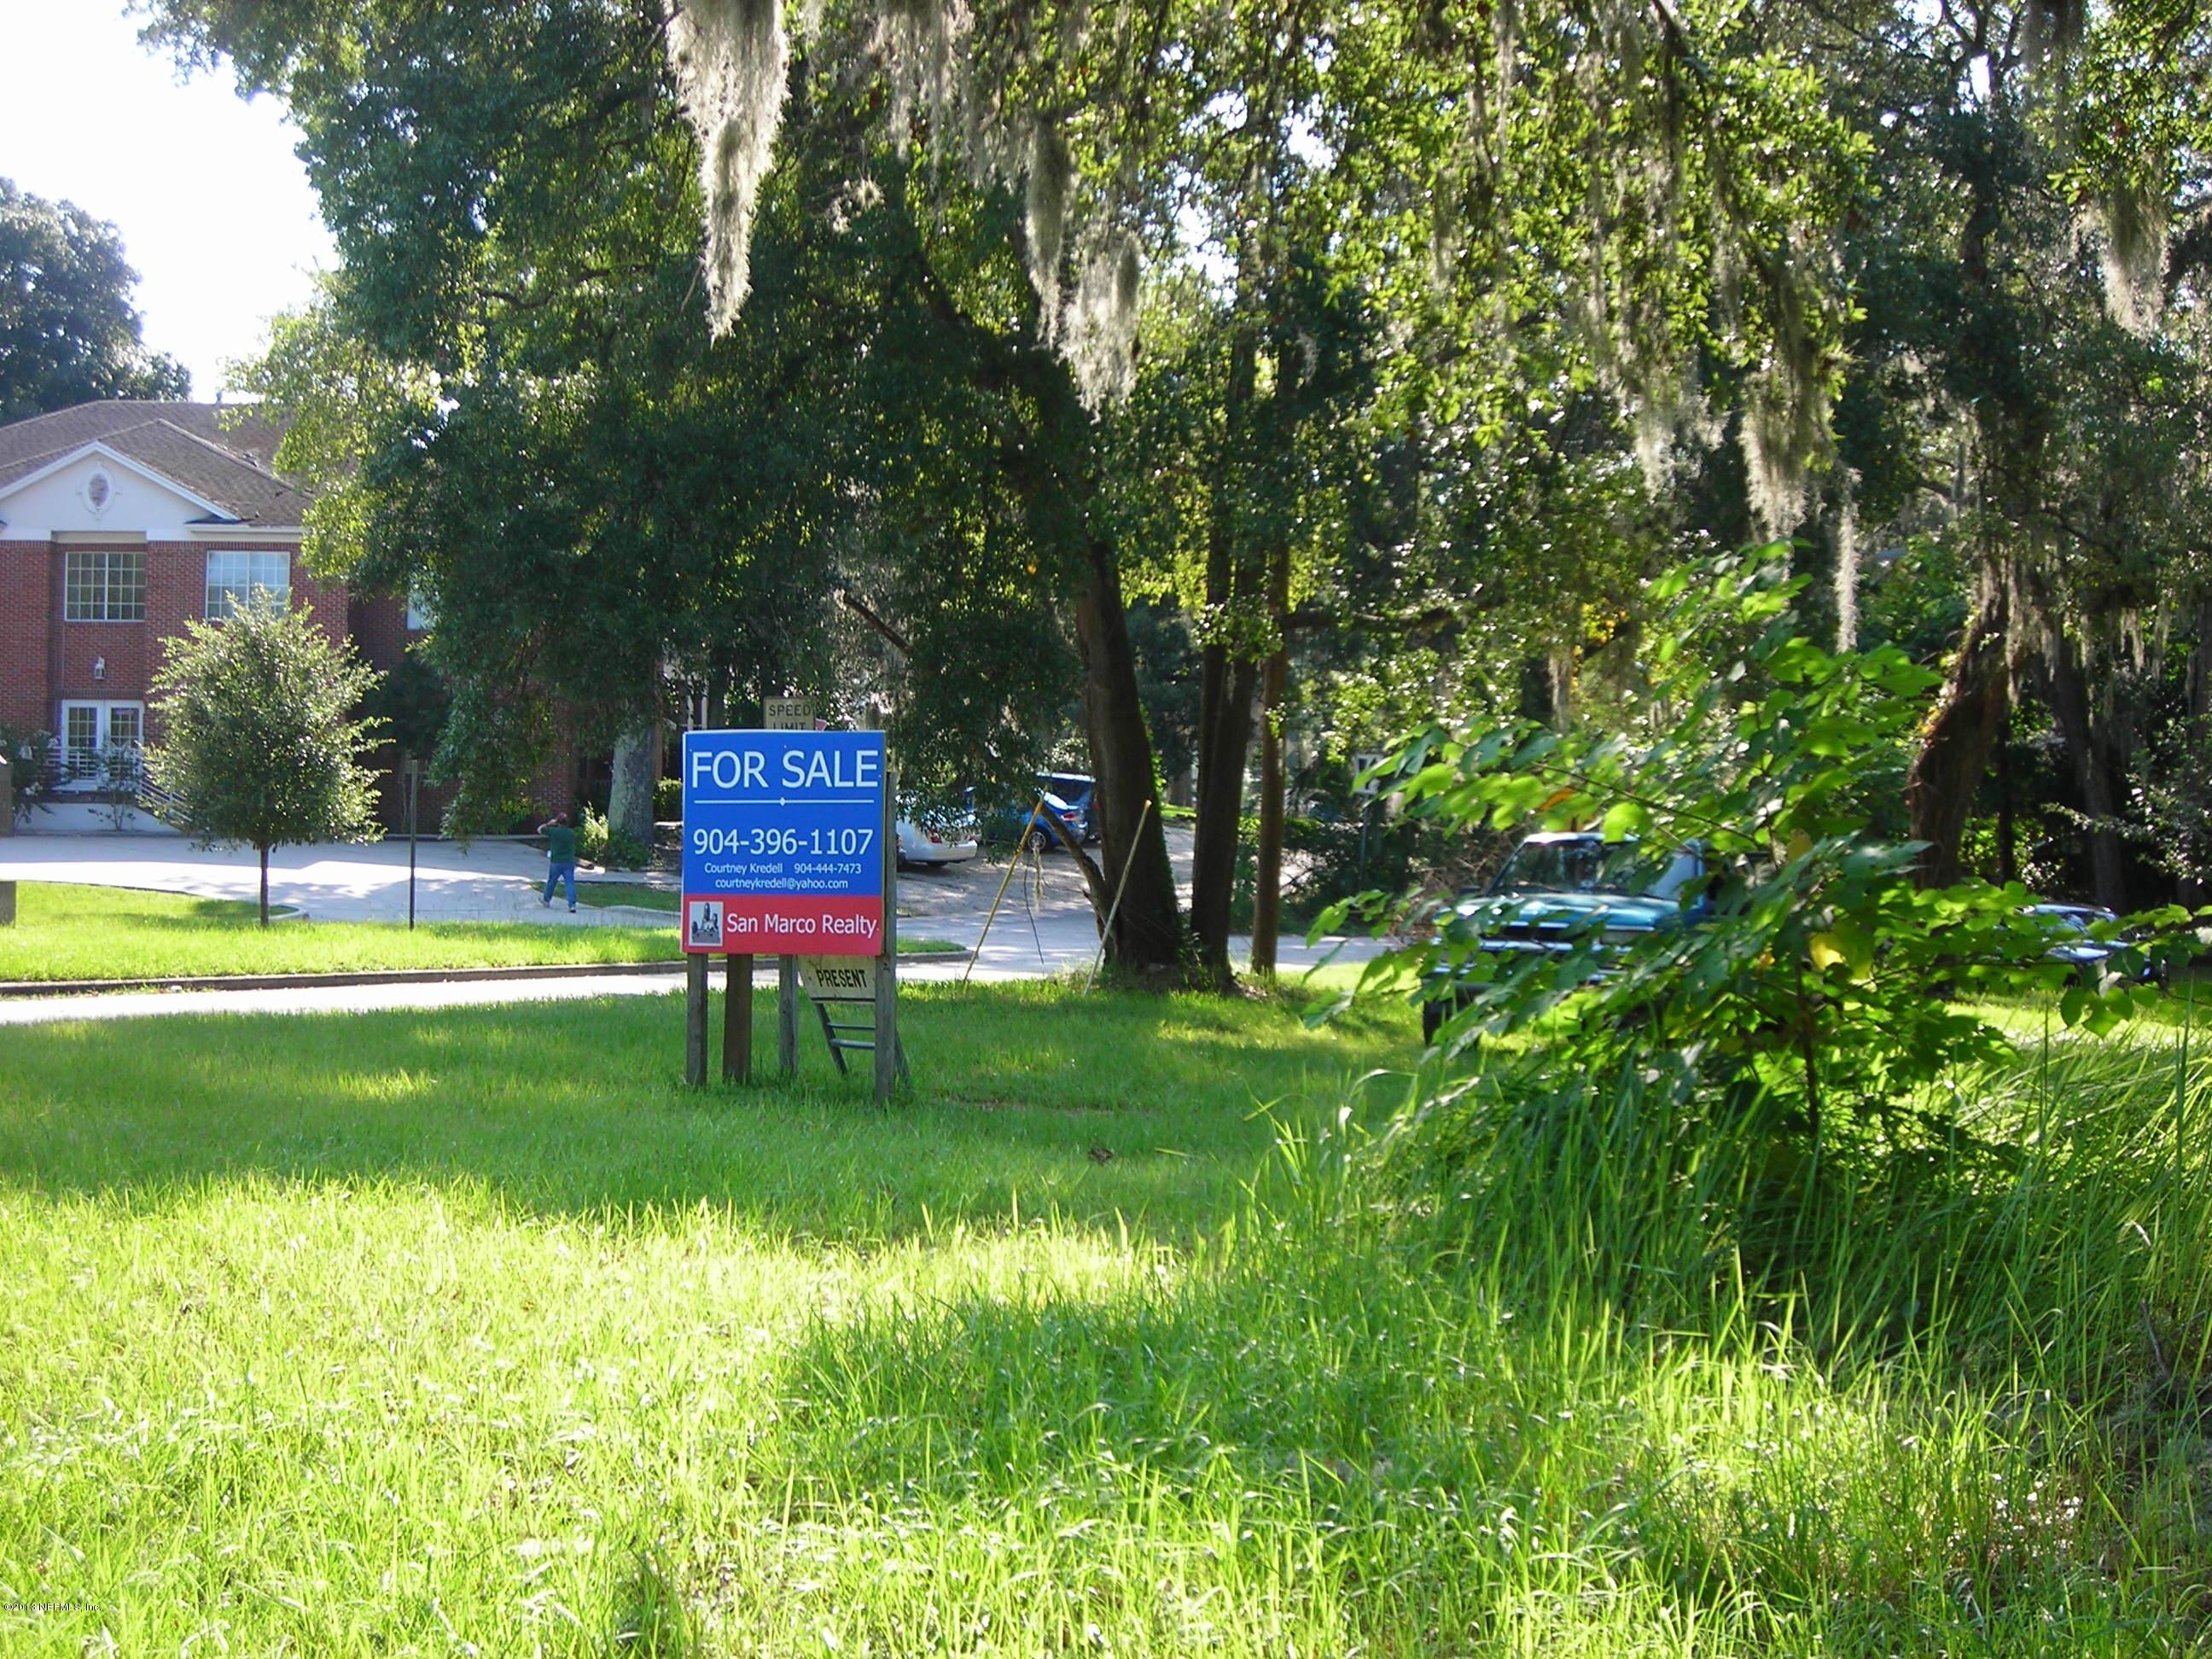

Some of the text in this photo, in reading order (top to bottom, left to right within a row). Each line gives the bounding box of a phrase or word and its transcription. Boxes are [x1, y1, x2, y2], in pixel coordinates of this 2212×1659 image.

[769, 704, 811, 716] SPEED
[692, 750, 878, 789] FOR SALE
[693, 828, 873, 855] 904-396-1107
[704, 863, 862, 875] Courtney Kredell 904-444-7473
[715, 878, 848, 890] courtneykredell@yahoo.com
[727, 913, 877, 939] San Marco Realty
[815, 969, 867, 987] PRESENT
